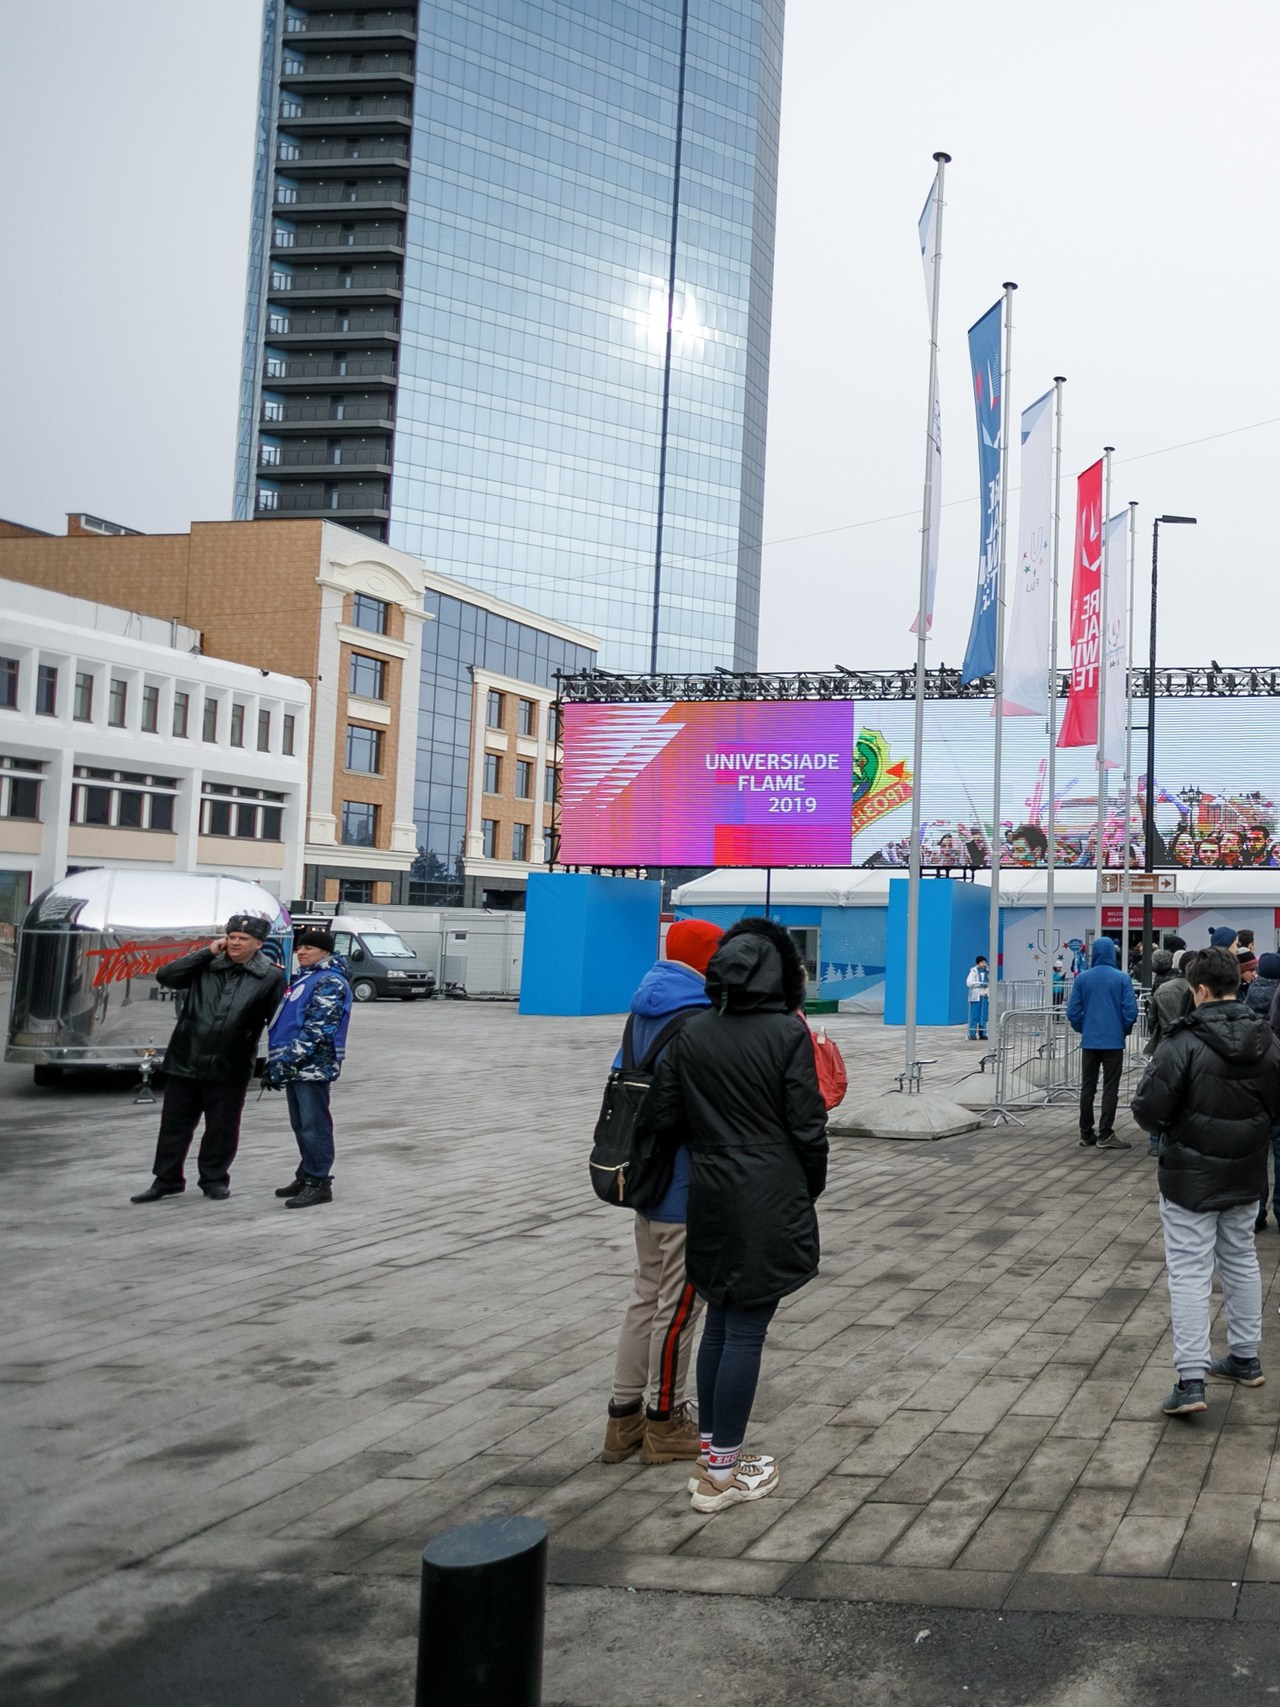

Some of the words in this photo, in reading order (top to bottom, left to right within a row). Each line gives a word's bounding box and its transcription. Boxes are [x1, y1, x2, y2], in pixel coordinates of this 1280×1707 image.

[705, 754, 840, 770] UNIVERSIADE
[738, 775, 806, 791] FLAME
[768, 797, 817, 813] 2019
